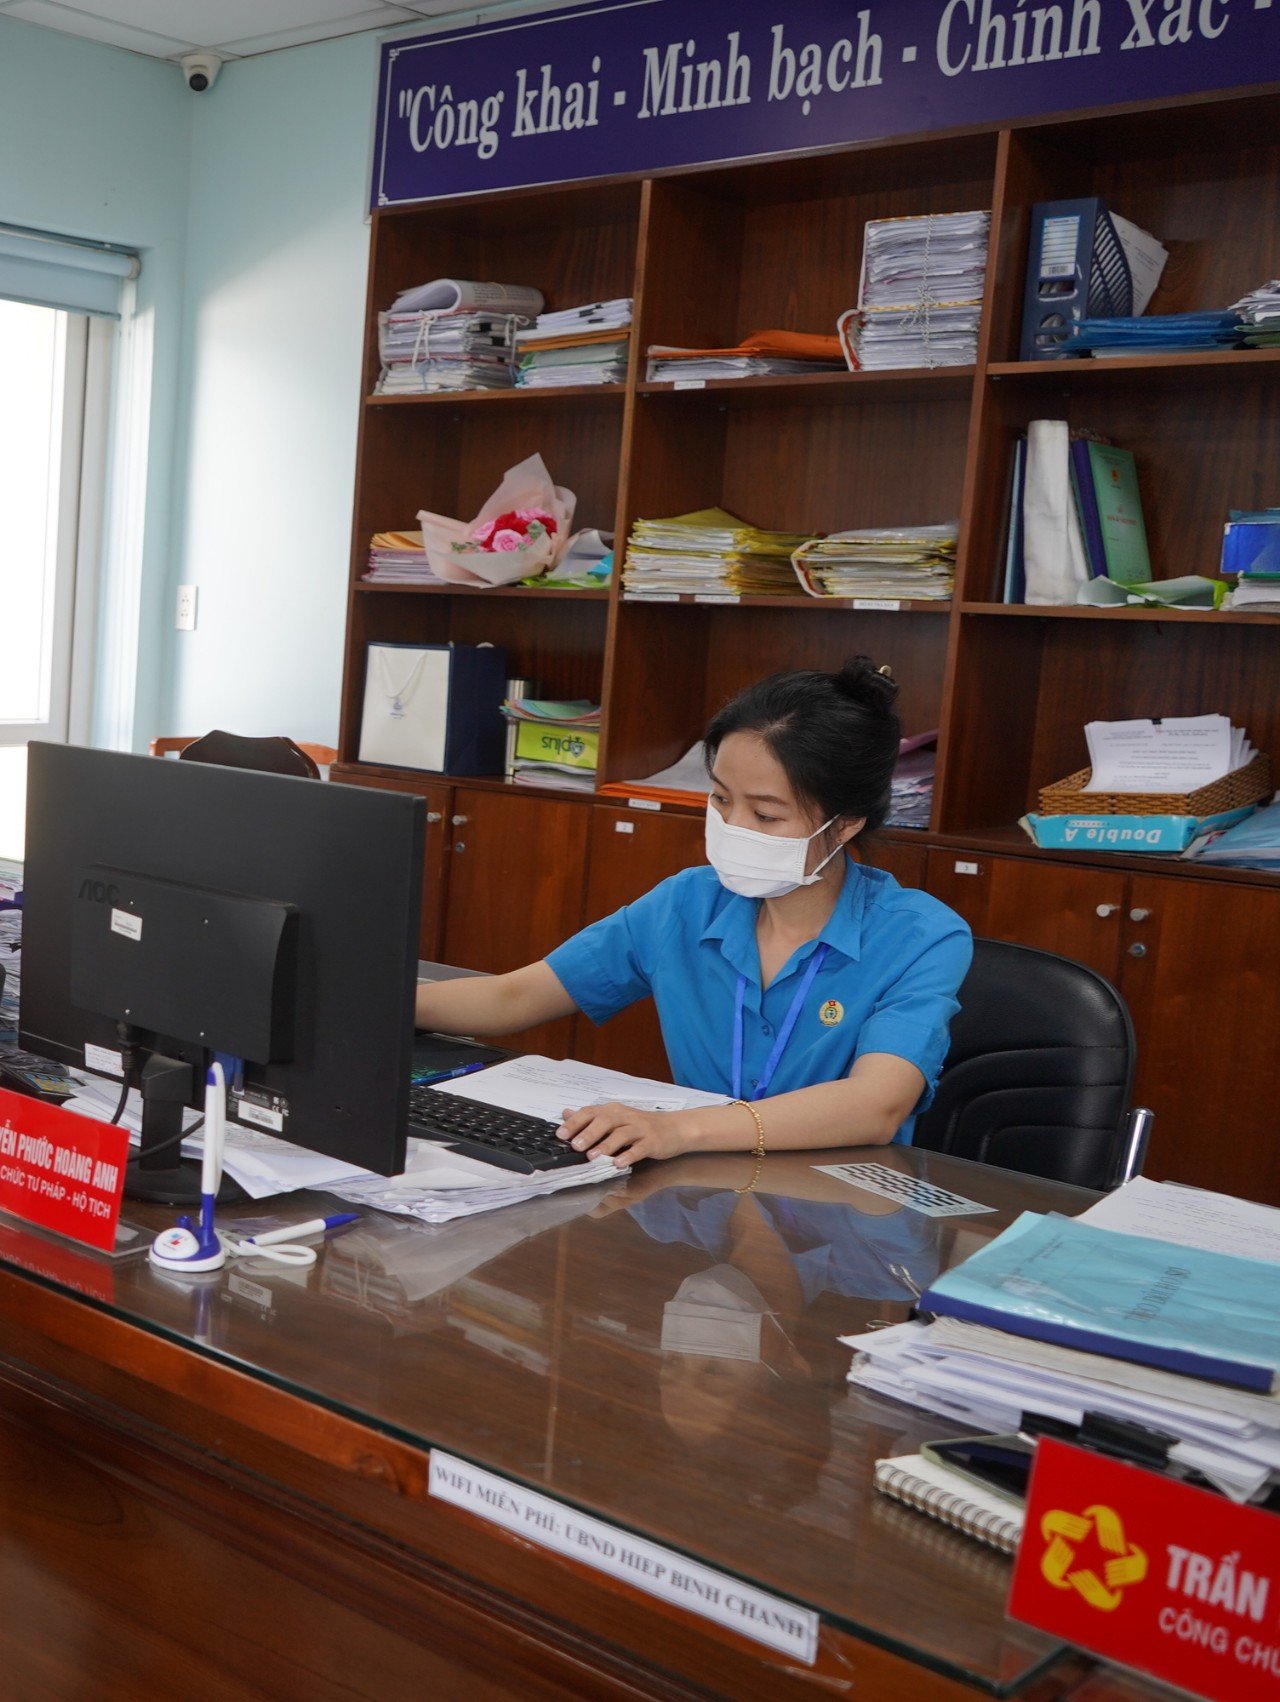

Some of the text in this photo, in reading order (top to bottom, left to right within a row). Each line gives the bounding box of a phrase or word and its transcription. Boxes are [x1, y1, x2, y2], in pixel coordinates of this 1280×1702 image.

[398, 85, 504, 160] "Công
[511, 56, 601, 137] khai
[637, 31, 751, 119] Minh
[767, 10, 883, 116] bạch
[1064, 828, 1162, 843] Double A
[0, 1162, 25, 1187] CHỨC
[27, 1173, 40, 1192] TƯ
[39, 1178, 66, 1201] PHÁP
[72, 1190, 88, 1212] HỘ
[88, 1198, 112, 1219] TỊCH
[18, 1134, 54, 1171] PHƯỚC
[53, 1145, 93, 1184] HOÀNG
[92, 1160, 119, 1194] ANH
[436, 1465, 472, 1494] WIFI
[564, 1523, 616, 1559] UBND
[620, 1548, 666, 1580] HIEP
[670, 1569, 719, 1604] BINH
[725, 1593, 803, 1638] CHANH
[1159, 1606, 1229, 1655] CÔNG
